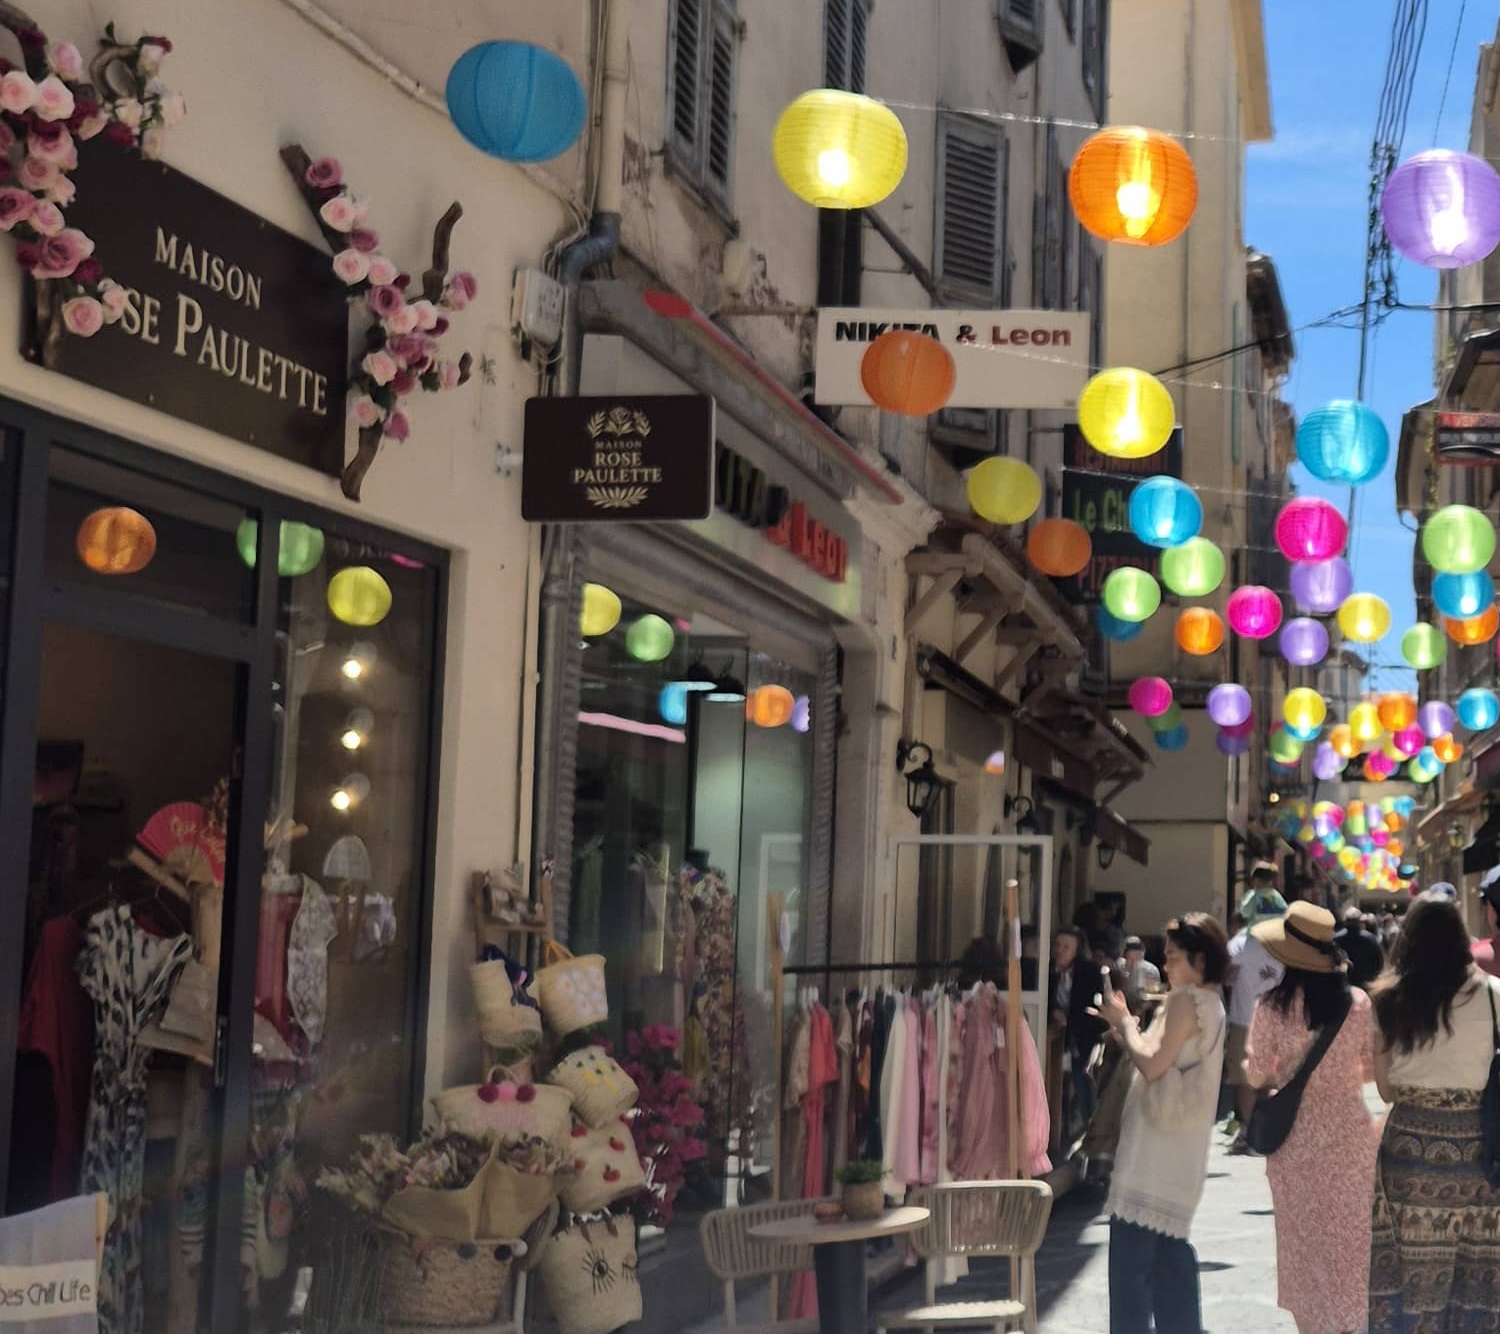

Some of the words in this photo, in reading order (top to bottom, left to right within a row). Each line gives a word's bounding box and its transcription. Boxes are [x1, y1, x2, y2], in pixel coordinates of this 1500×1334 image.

[155, 226, 262, 310] MAISON
[956, 325, 977, 343] &
[992, 325, 1072, 347] Leon
[121, 287, 161, 345] SE
[174, 292, 328, 416] PAULETTE
[594, 440, 643, 450] MAISON
[594, 451, 643, 467] ROSE
[573, 468, 663, 483] PAULETTE
[59, 1278, 91, 1304] Life
